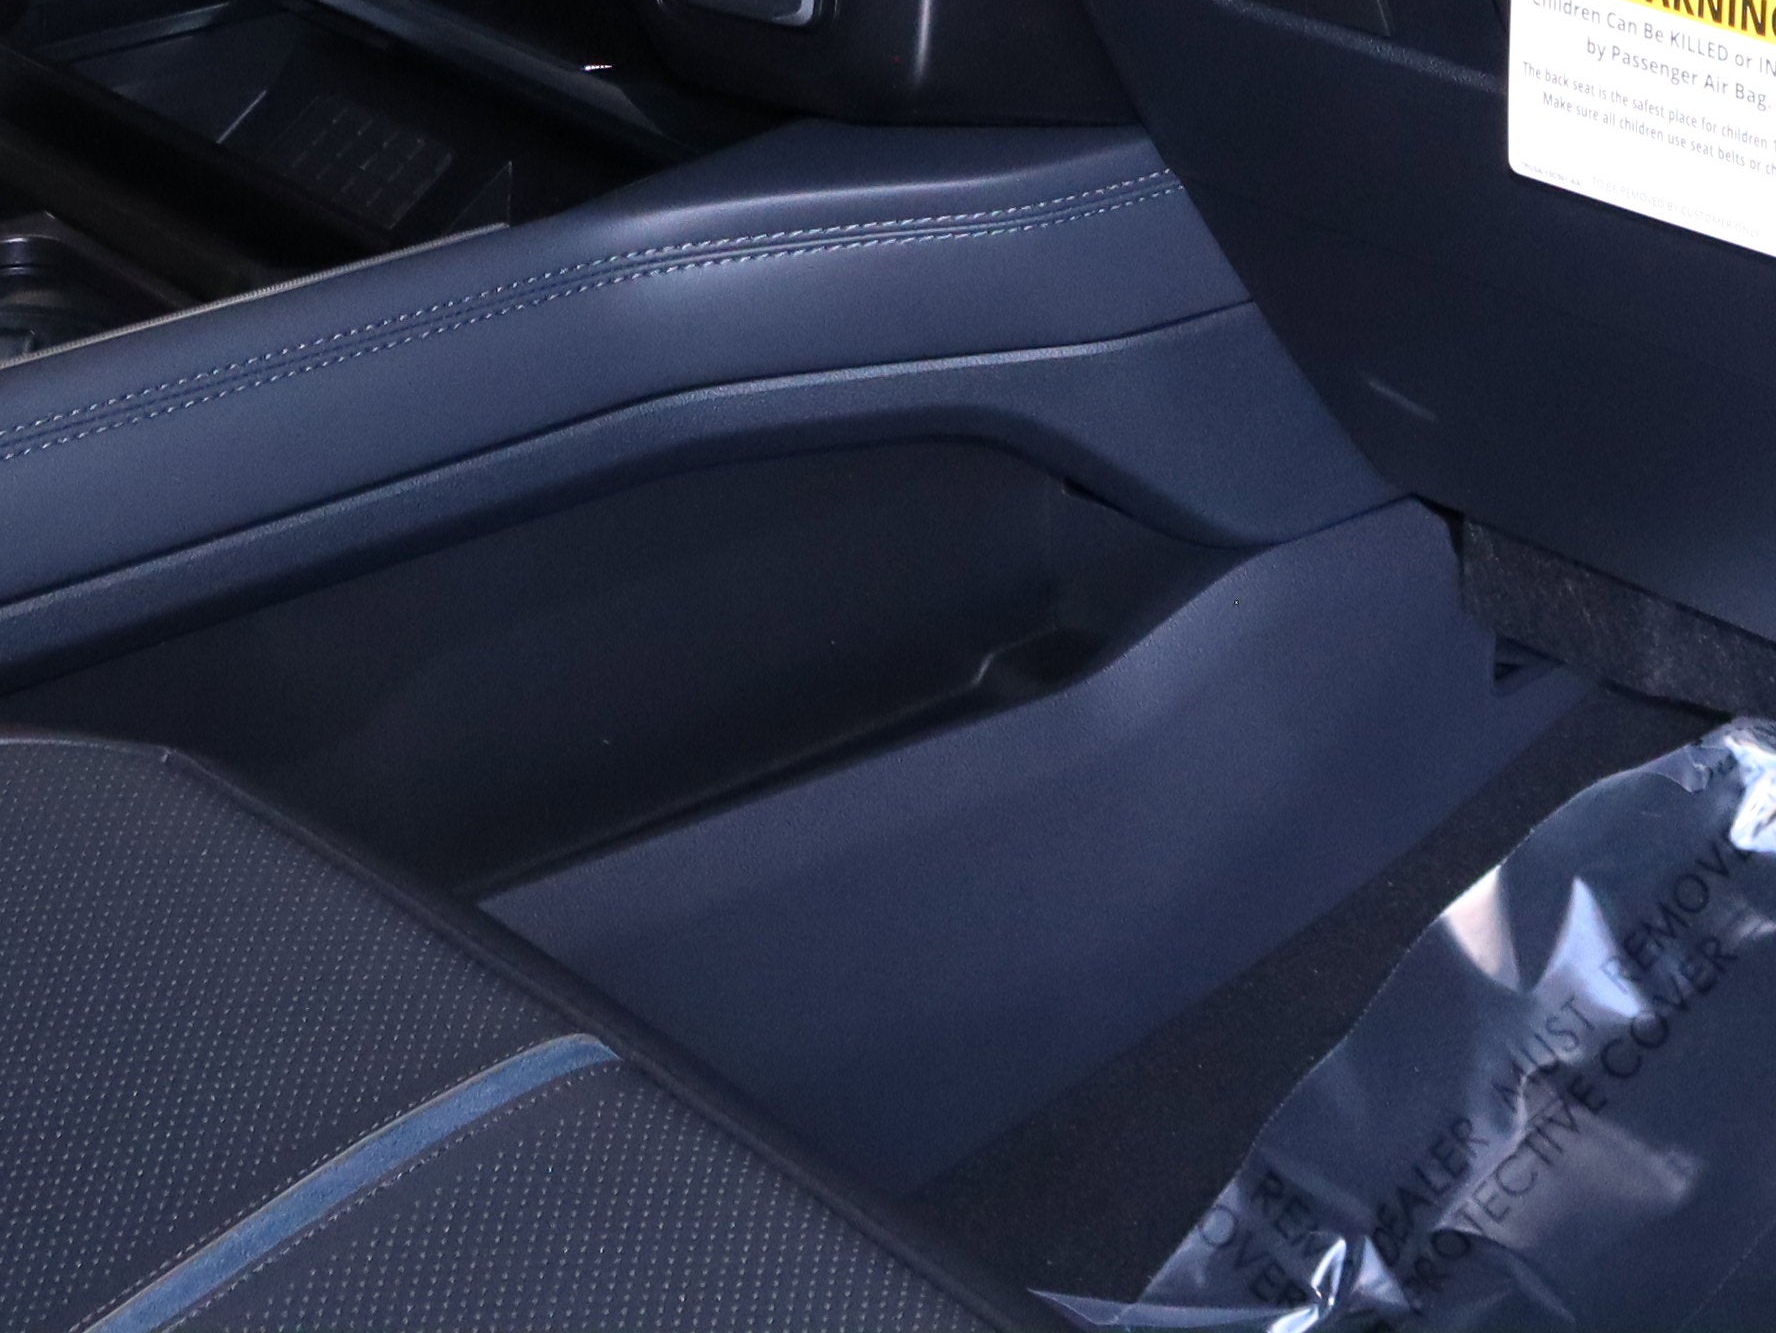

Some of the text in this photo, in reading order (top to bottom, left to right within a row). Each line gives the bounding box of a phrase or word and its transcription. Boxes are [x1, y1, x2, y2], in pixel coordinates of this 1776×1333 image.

[1586, 36, 1772, 112] by Passenger Air Bag.
[1606, 11, 1638, 35] Can
[1643, 22, 1664, 43] Be
[1670, 30, 1728, 62] KILLED
[1735, 53, 1753, 69] or
[1522, 60, 1541, 80] The
[1544, 69, 1569, 87] back
[1572, 80, 1595, 97] seat
[1598, 87, 1607, 100] is
[1610, 90, 1629, 107] the
[1631, 99, 1665, 119] safest
[1668, 109, 1698, 128] place
[1701, 116, 1717, 133] for
[1721, 125, 1768, 150] children
[1542, 91, 1573, 113] Make
[1576, 104, 1599, 121] sure
[1602, 112, 1616, 127] all
[1618, 117, 1664, 142] children
[1667, 133, 1687, 149] use
[1690, 140, 1714, 158] seat
[1717, 145, 1746, 167] belts
[1749, 158, 1761, 171] or
[1372, 1116, 1490, 1267] DEALER
[1491, 995, 1595, 1113] MUST
[1401, 935, 1739, 1319] PROTECTIVE COVER
